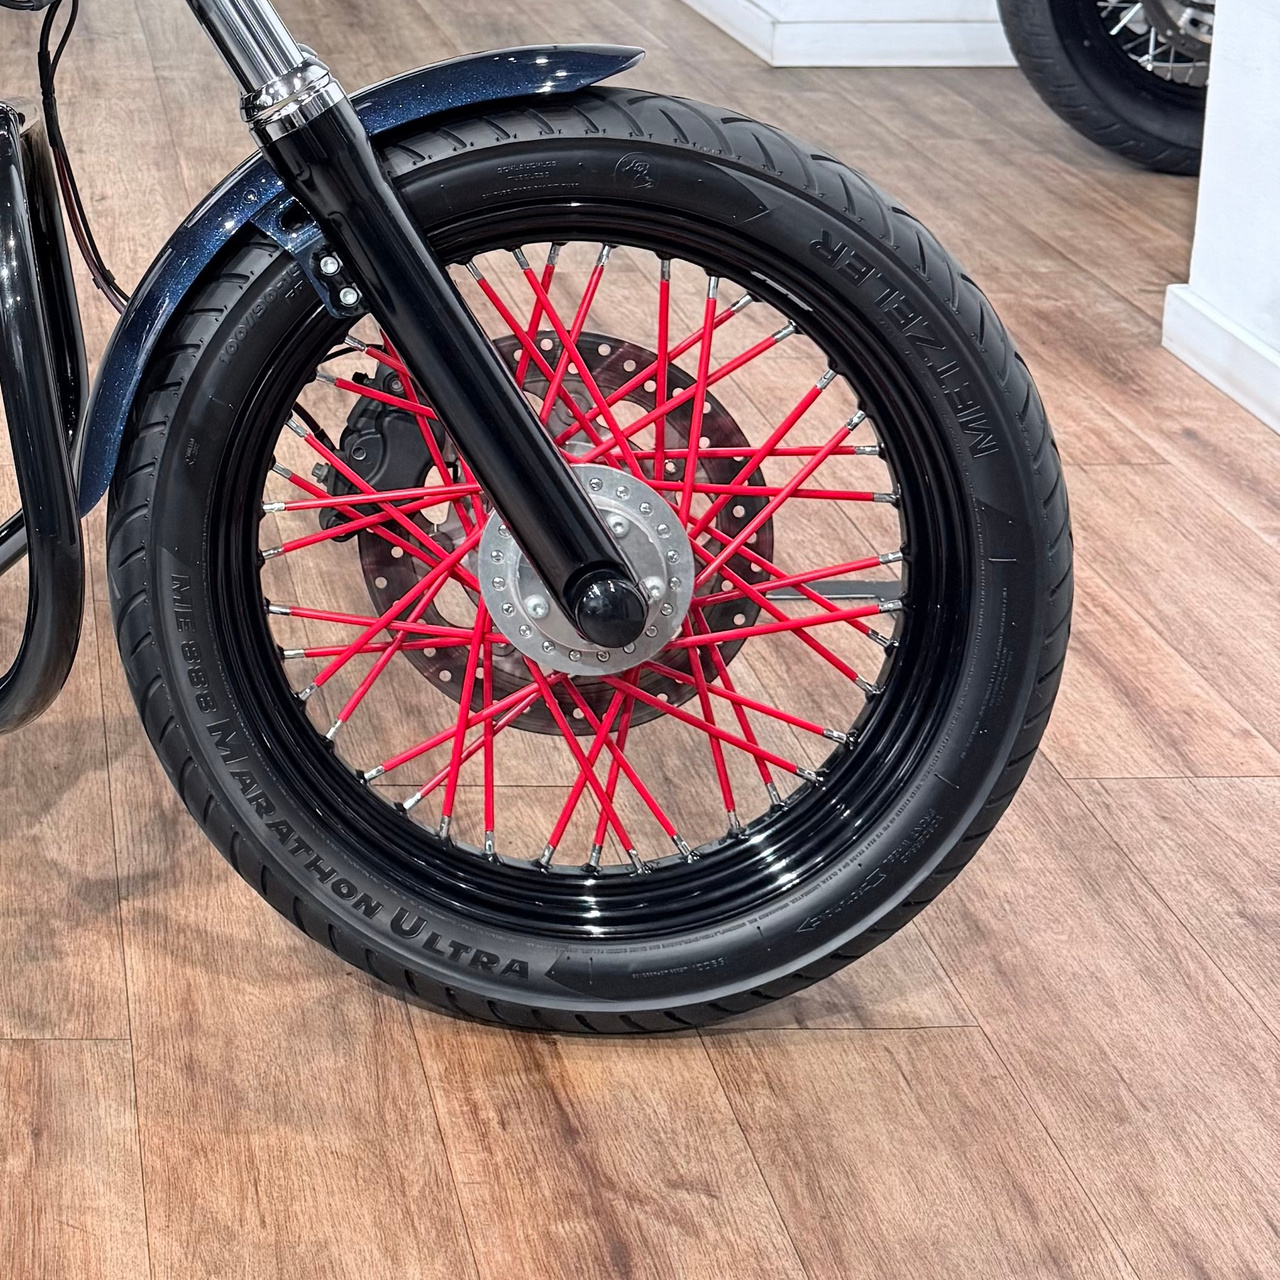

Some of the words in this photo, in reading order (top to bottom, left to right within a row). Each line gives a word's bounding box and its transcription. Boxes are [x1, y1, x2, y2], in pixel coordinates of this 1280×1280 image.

[808, 228, 1000, 459] METZELER
[171, 572, 196, 634] ME
[205, 717, 385, 920] MARATHON
[389, 907, 530, 980] ULTRA
